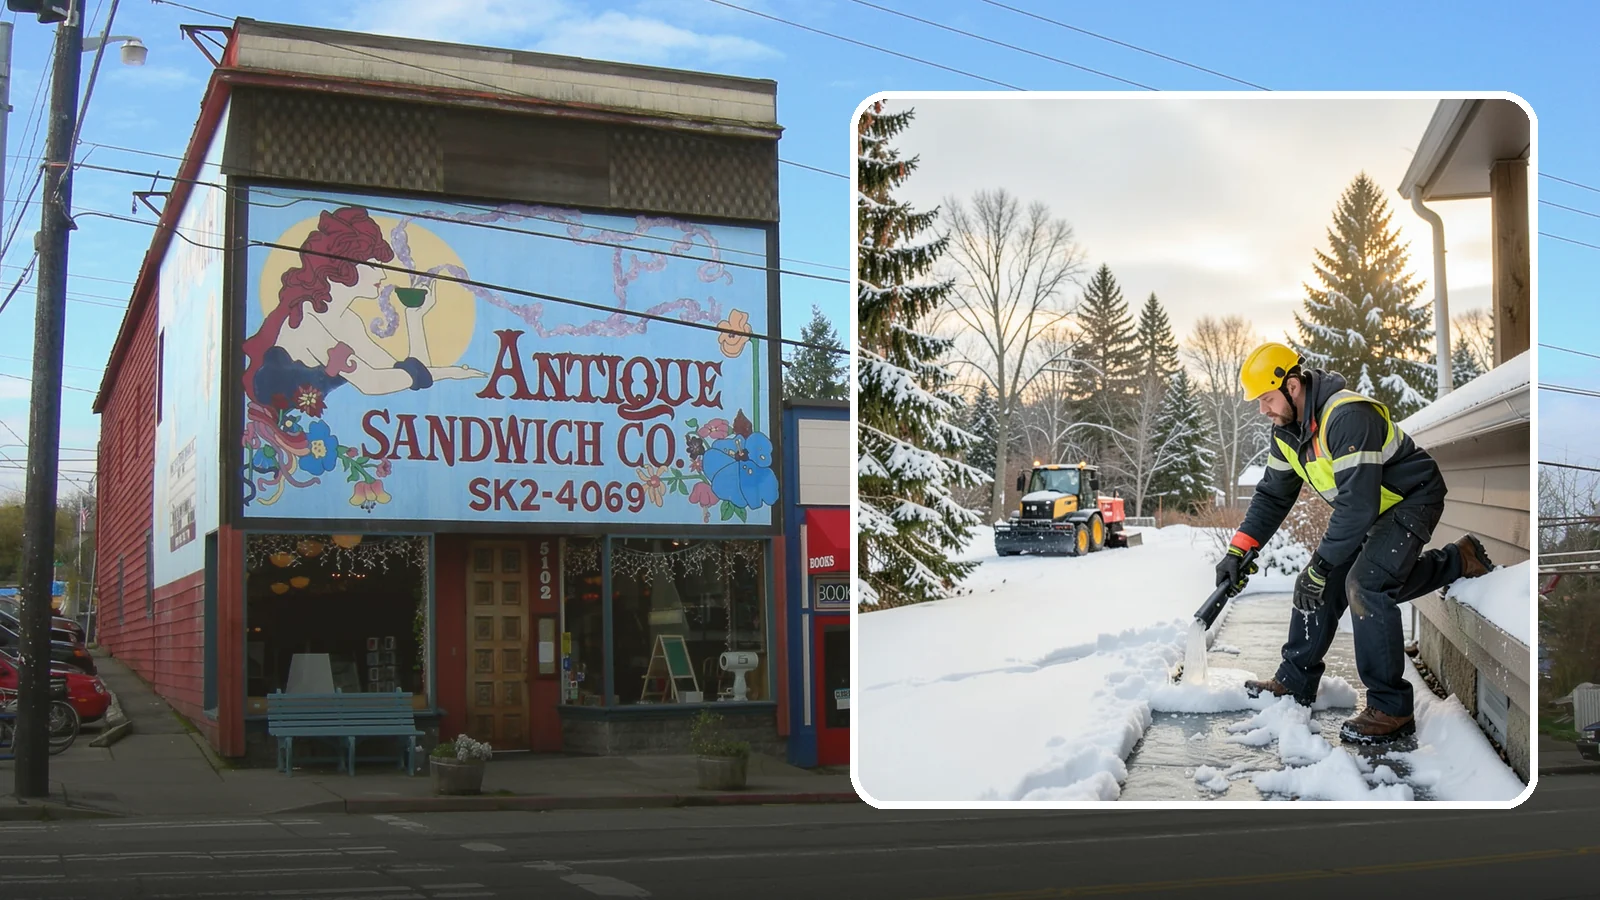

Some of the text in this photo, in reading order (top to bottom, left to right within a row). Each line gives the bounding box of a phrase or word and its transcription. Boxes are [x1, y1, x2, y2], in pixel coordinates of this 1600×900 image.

[475, 329, 723, 421] ANTIQUE
[361, 408, 685, 469] SANDWICH CO.
[468, 477, 646, 512] SK2-4069
[540, 541, 552, 599] 5102
[809, 554, 835, 568] BOOKS
